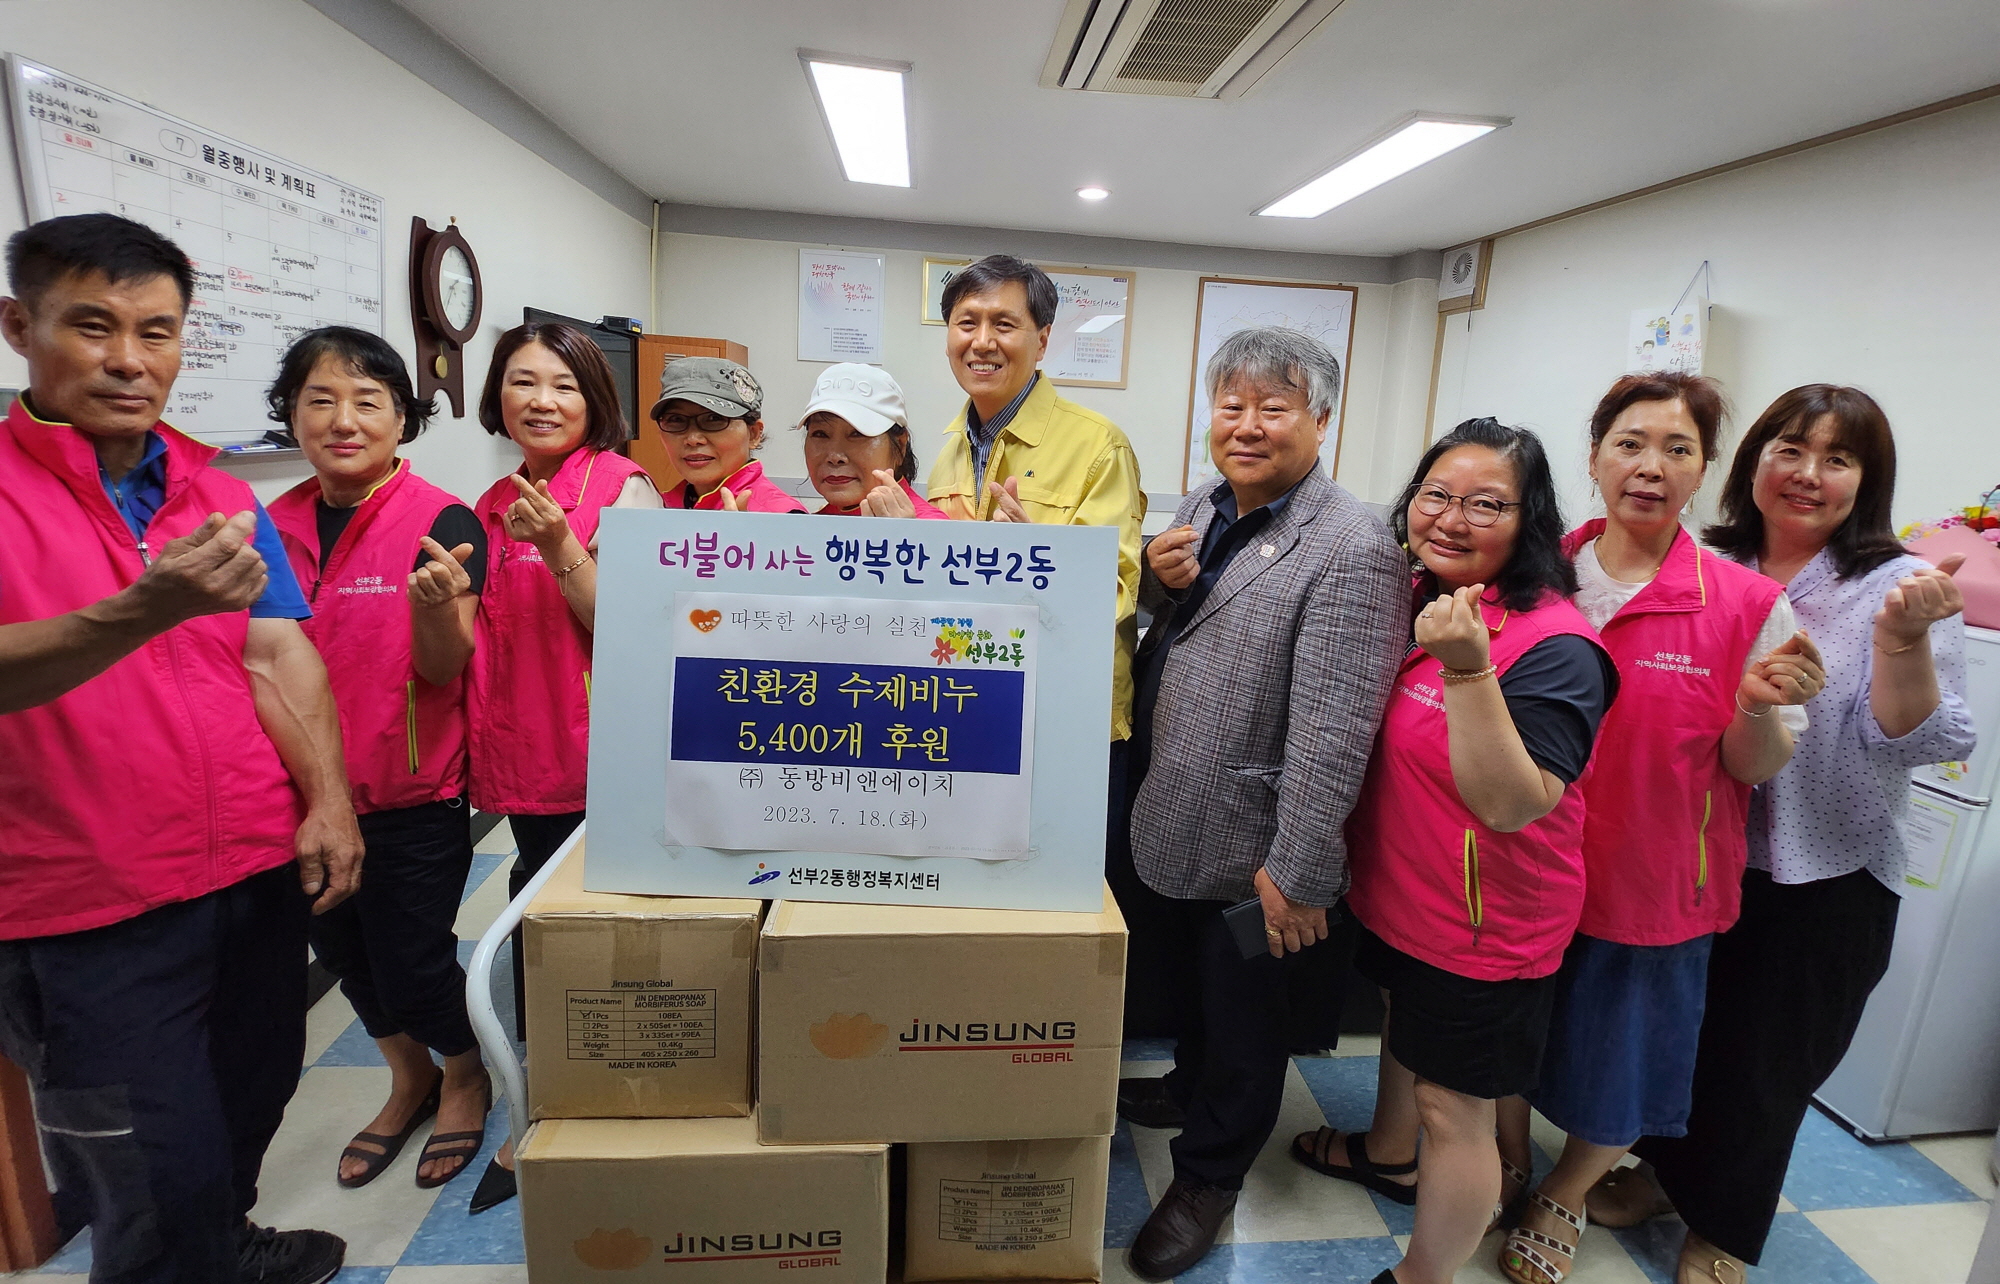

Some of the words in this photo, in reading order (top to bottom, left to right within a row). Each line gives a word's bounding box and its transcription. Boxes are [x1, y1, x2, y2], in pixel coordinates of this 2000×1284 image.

[75, 136, 93, 149] SUN
[175, 137, 184, 151] 7
[138, 155, 154, 168] MON
[202, 143, 260, 180] 월중행사
[264, 167, 276, 186] 및
[281, 172, 316, 200] 계획표
[194, 174, 206, 185] TUE
[56, 192, 66, 202] 2
[243, 191, 256, 201] WED
[119, 204, 126, 213] 3
[176, 219, 182, 229] 4
[227, 232, 233, 241] 5
[274, 245, 279, 254] 6
[228, 306, 236, 315] 19
[274, 313, 282, 321] 20
[659, 532, 755, 578] 더불어
[765, 545, 815, 577] 사는
[825, 534, 931, 585] 행복한
[941, 544, 1057, 590] 선부2동
[354, 576, 383, 586] 선부2동
[731, 608, 796, 633] 따뜻한
[807, 611, 871, 636] 사랑의
[886, 615, 927, 638] 실천
[965, 642, 1025, 667] 선부2동
[1654, 651, 1693, 665] 선부2동
[1635, 659, 1711, 677] 지역사회보장협의체
[716, 666, 819, 706] 친환경
[837, 671, 979, 714] 수제비누
[1413, 682, 1439, 698] 선부2동
[738, 721, 863, 759] 5,400개
[881, 722, 950, 762] 후원
[778, 767, 954, 798] 동방비앤에이치
[763, 805, 817, 825] 2023.
[828, 808, 846, 826] 7.
[858, 809, 929, 831] 18.(화)
[788, 866, 940, 892] 선부2동행정복지센터
[611, 980, 644, 989] Jinsung
[645, 979, 673, 988] Global
[570, 998, 599, 1006] Product
[583, 1042, 610, 1050] Weight
[657, 1041, 683, 1049] 10.4Kg
[1011, 1052, 1074, 1064] GLOBAL
[608, 1061, 635, 1069] MADE
[981, 1172, 1010, 1181] Jinsung
[943, 1186, 969, 1194] Product
[1014, 1183, 1065, 1192] DENDROPANAX
[1046, 1188, 1066, 1196] SOAP
[778, 1256, 841, 1270] GLOBAL
